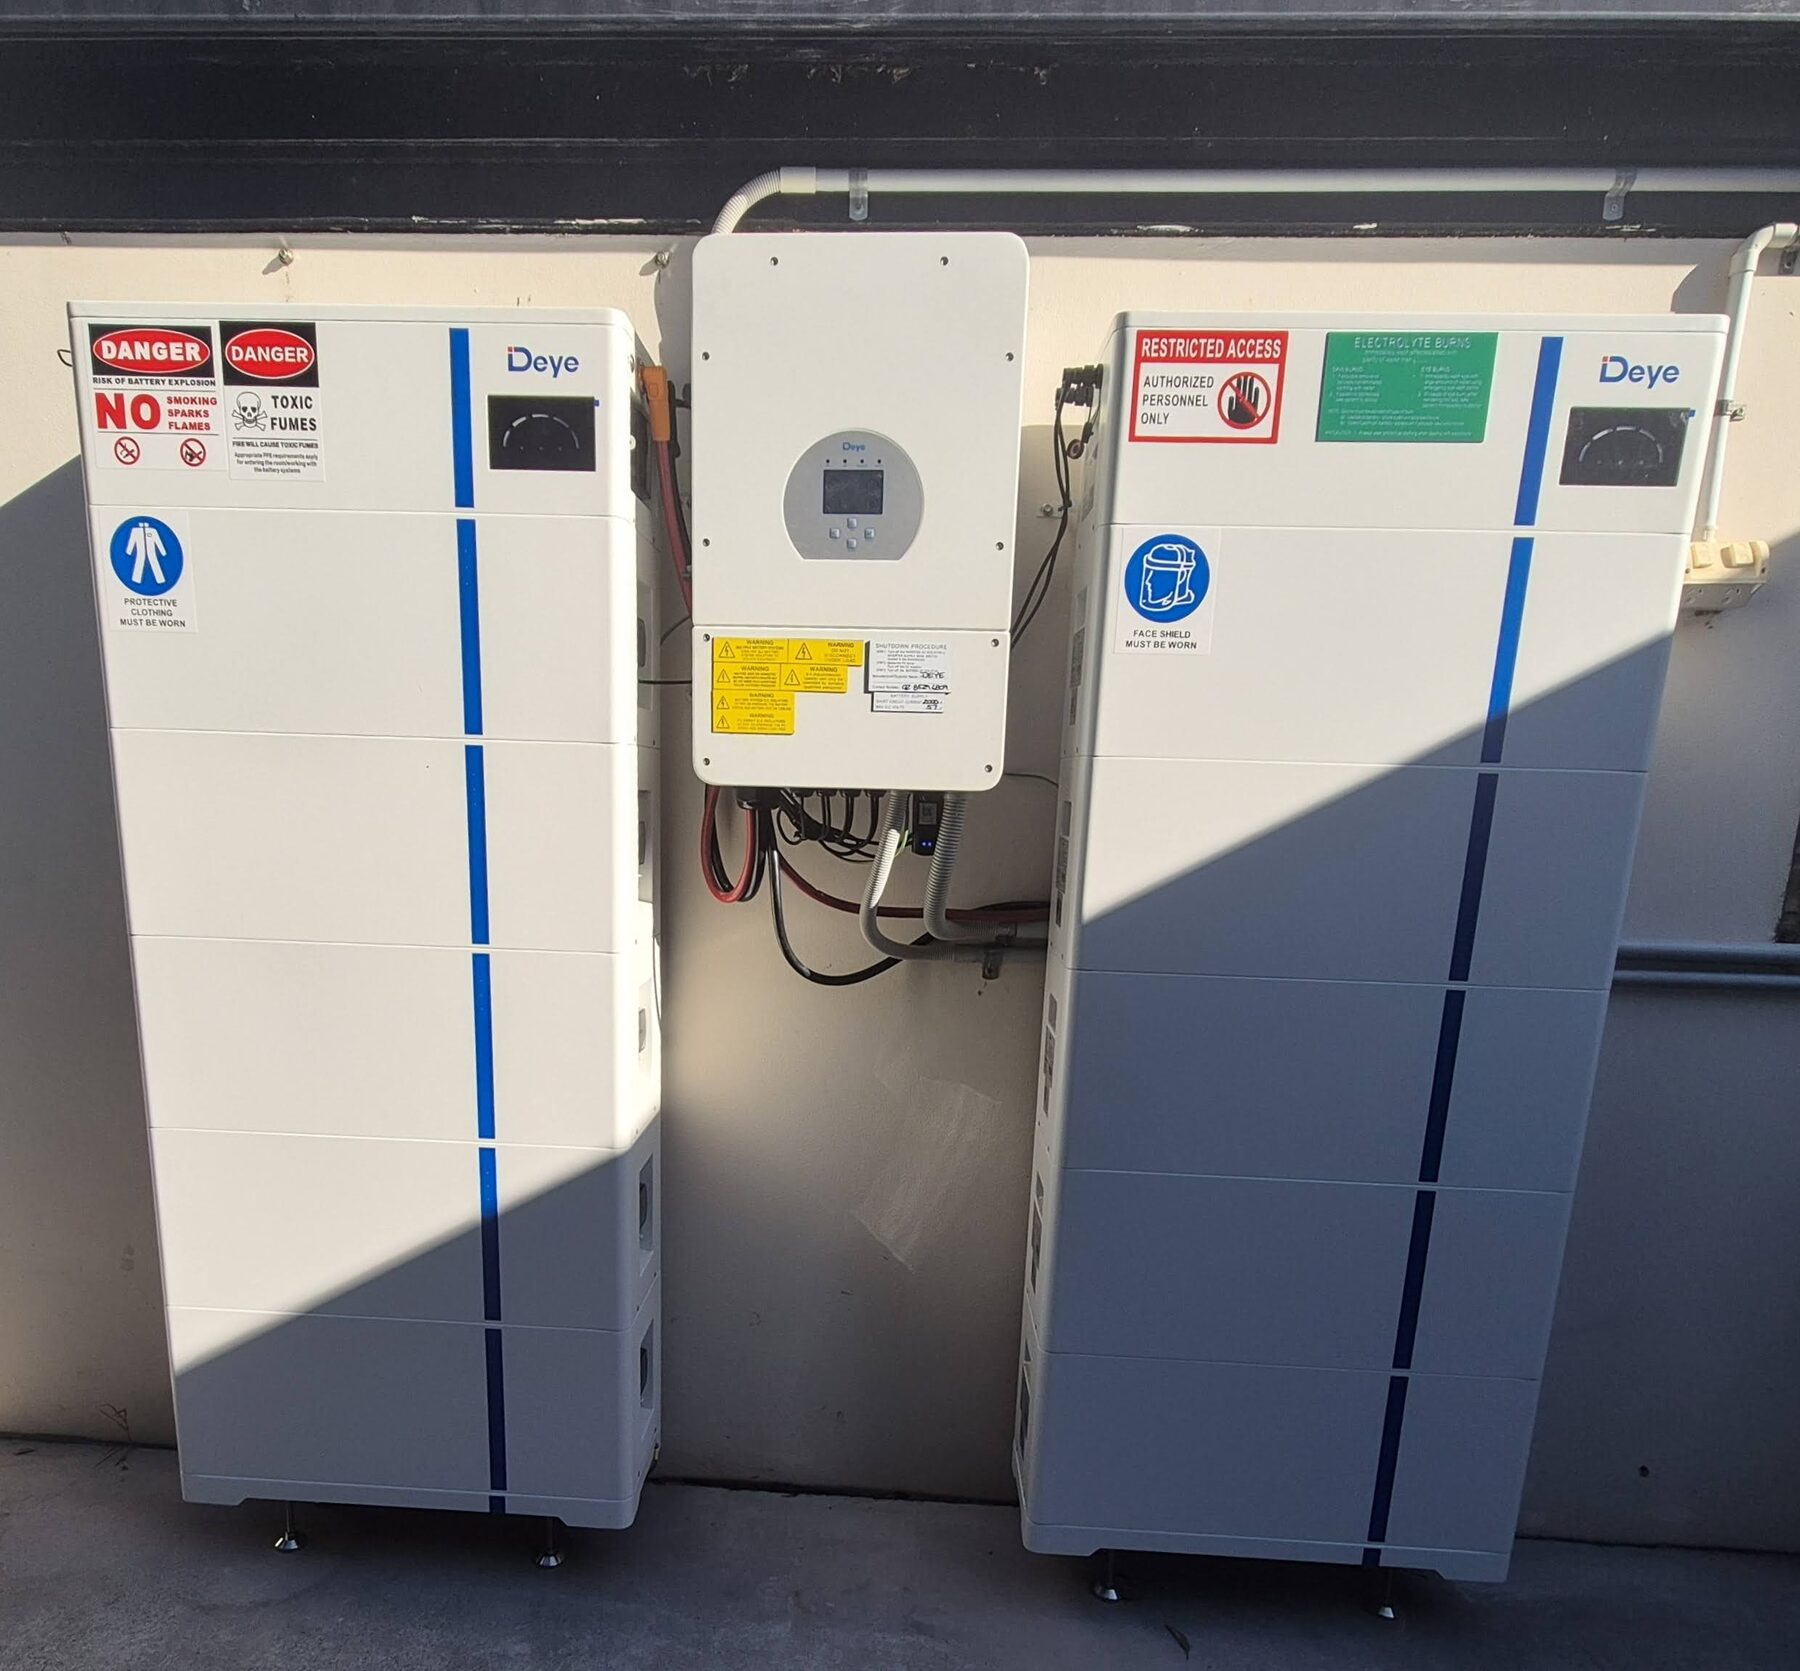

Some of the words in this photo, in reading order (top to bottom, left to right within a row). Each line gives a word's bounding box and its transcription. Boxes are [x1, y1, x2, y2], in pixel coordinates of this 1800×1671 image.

[1141, 338, 1224, 358] RESTRICTED
[1226, 338, 1282, 359] ACCESS
[1354, 337, 1431, 349] ELECTROLYTE
[1435, 337, 1472, 349] BURNS
[101, 340, 202, 361] DANGER
[231, 346, 309, 363] DANGER
[507, 346, 579, 378] Deye
[1599, 355, 1680, 389] Deye
[128, 378, 166, 386] BATTERY
[169, 379, 216, 387] EXPLOSION
[1143, 375, 1214, 388] AUTHORIZED
[167, 396, 218, 405] SMOKING
[271, 395, 313, 409] TOXIC
[1142, 394, 1208, 407] PERSONNEL
[95, 392, 161, 430] NO
[168, 409, 209, 418] SPARKS
[270, 417, 317, 431] FUMES
[1141, 412, 1169, 425] ONLY
[168, 422, 211, 431] FLAMES
[842, 442, 866, 452] Deye
[124, 598, 177, 607] PROTECTIVE
[130, 608, 173, 617] CLOTHING
[120, 618, 143, 626] MUST
[1133, 629, 1157, 638] FACE
[1159, 630, 1191, 639] SHIELD
[1125, 640, 1151, 648] MUST
[1153, 641, 1166, 649] BE
[1168, 641, 1197, 649] WORN
